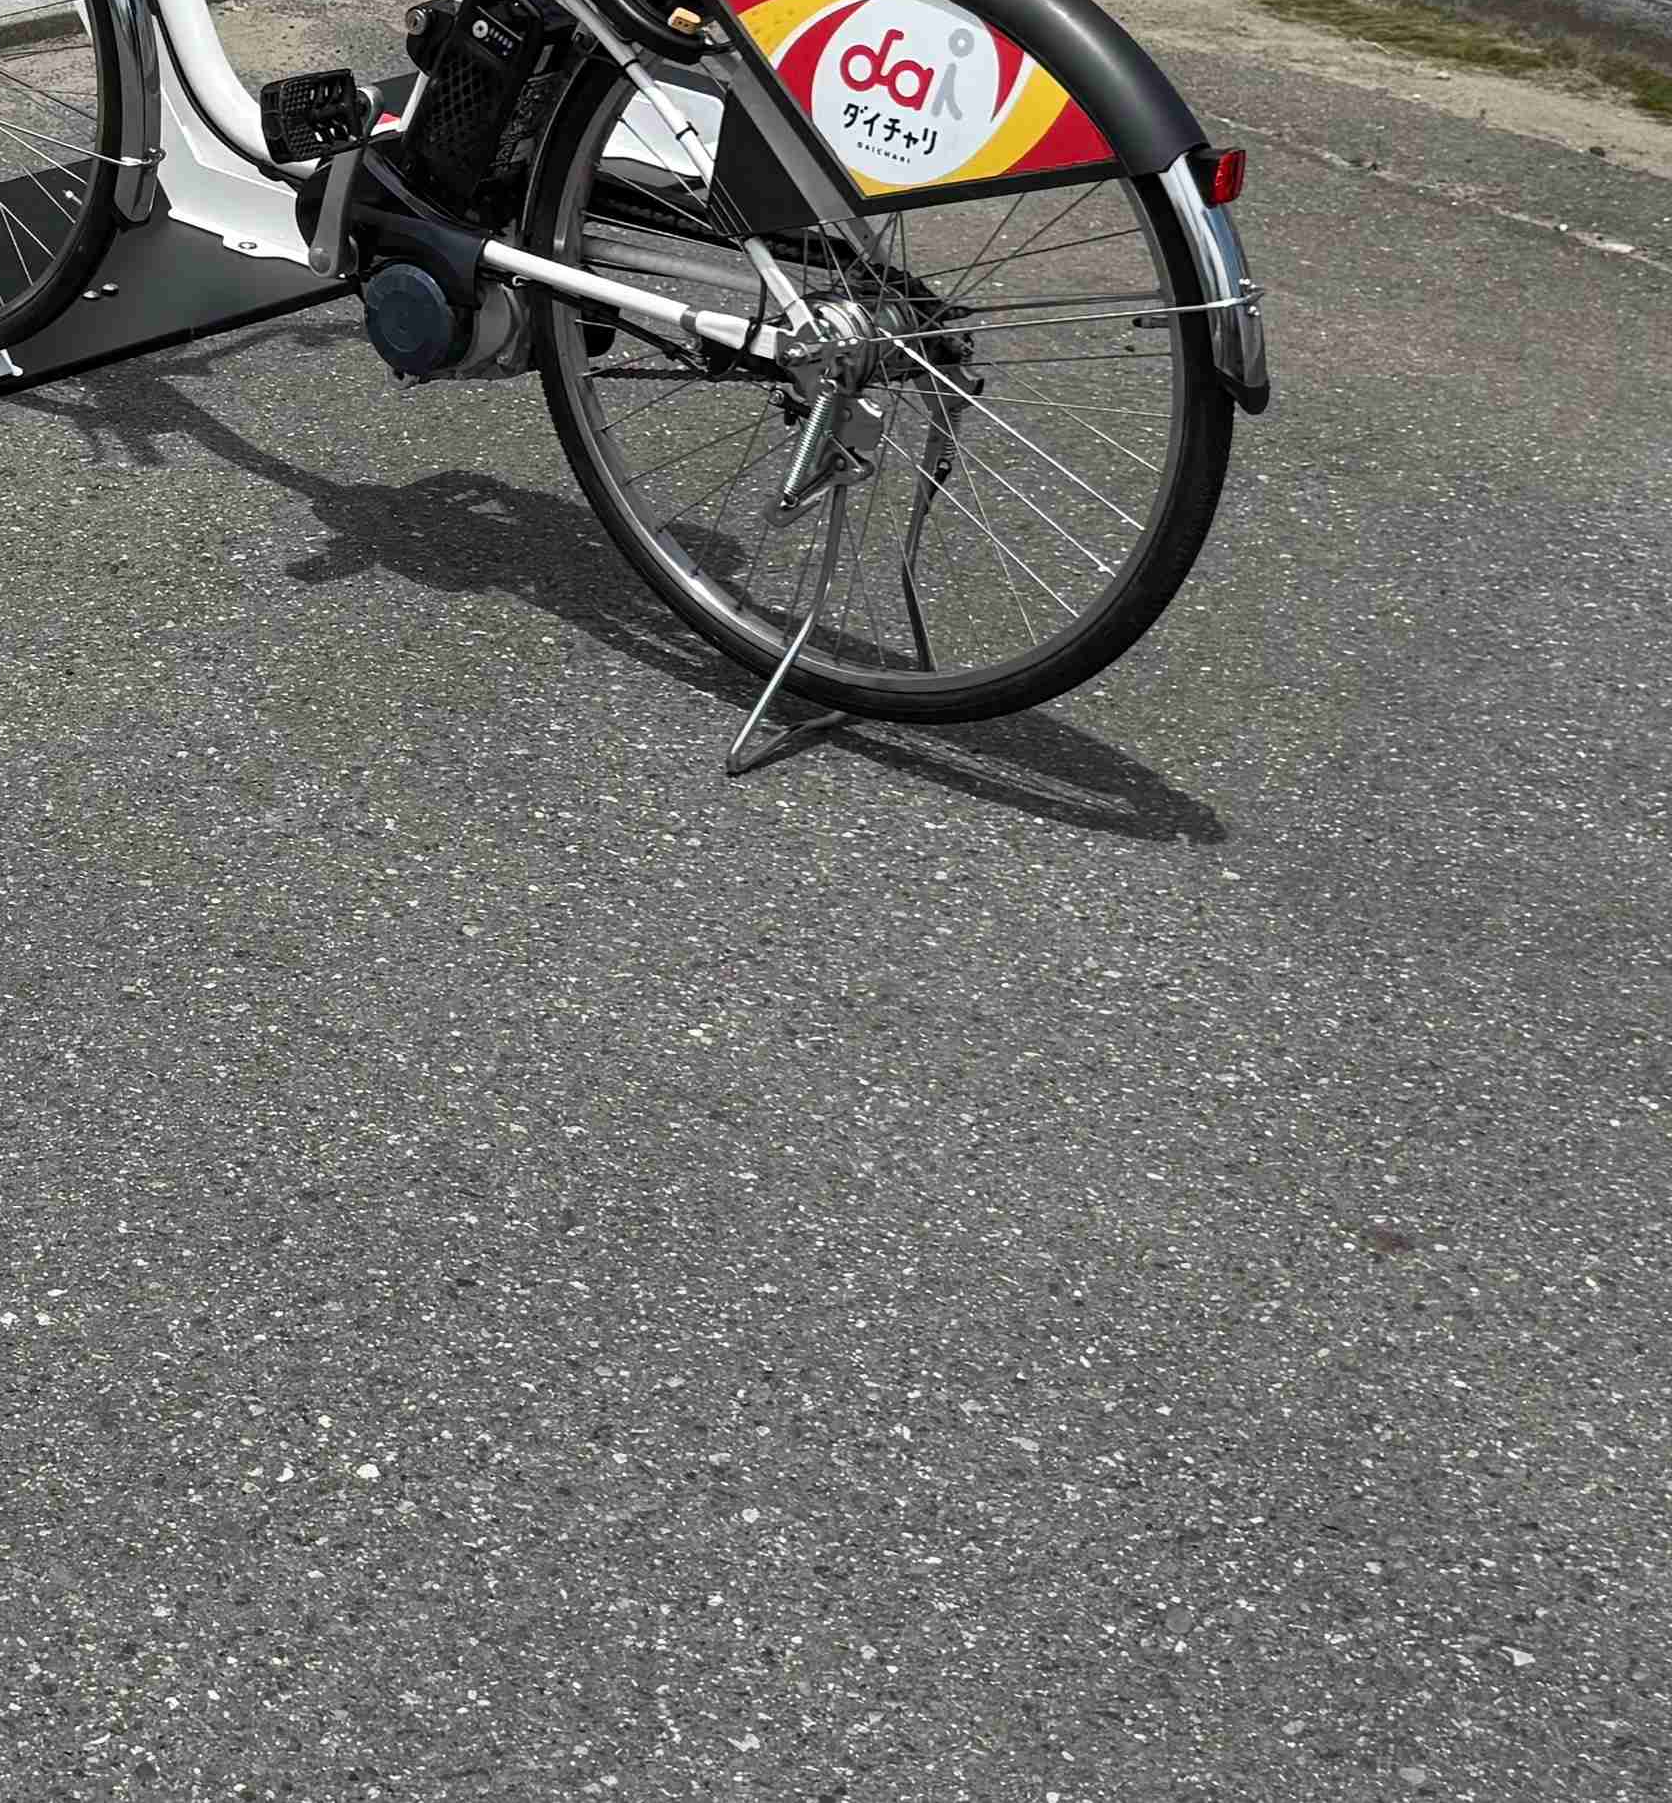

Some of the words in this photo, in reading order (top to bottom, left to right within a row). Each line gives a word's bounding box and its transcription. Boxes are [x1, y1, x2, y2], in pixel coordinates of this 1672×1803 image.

[839, 28, 975, 122] dai
[843, 102, 938, 156] ダイチャリ
[857, 140, 912, 165] DAICHARI
